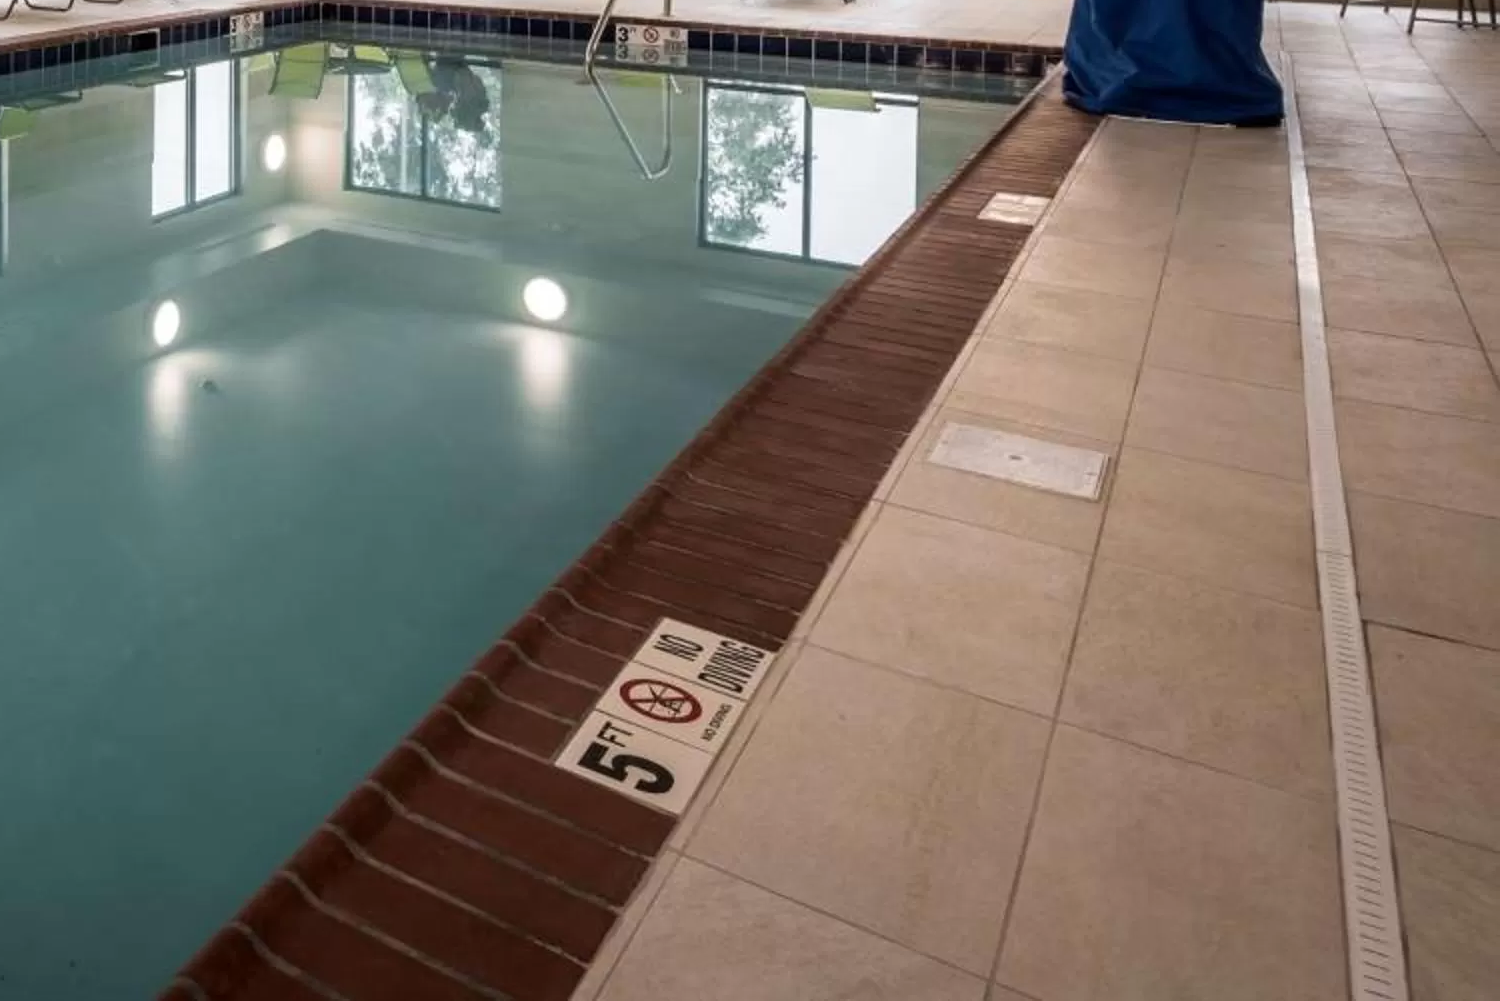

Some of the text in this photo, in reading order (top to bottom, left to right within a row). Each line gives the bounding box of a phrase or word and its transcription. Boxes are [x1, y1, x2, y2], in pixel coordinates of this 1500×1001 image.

[618, 26, 629, 42] 3
[653, 634, 704, 662] NO
[698, 640, 765, 694] DIVING
[577, 721, 675, 794] 5 FT
